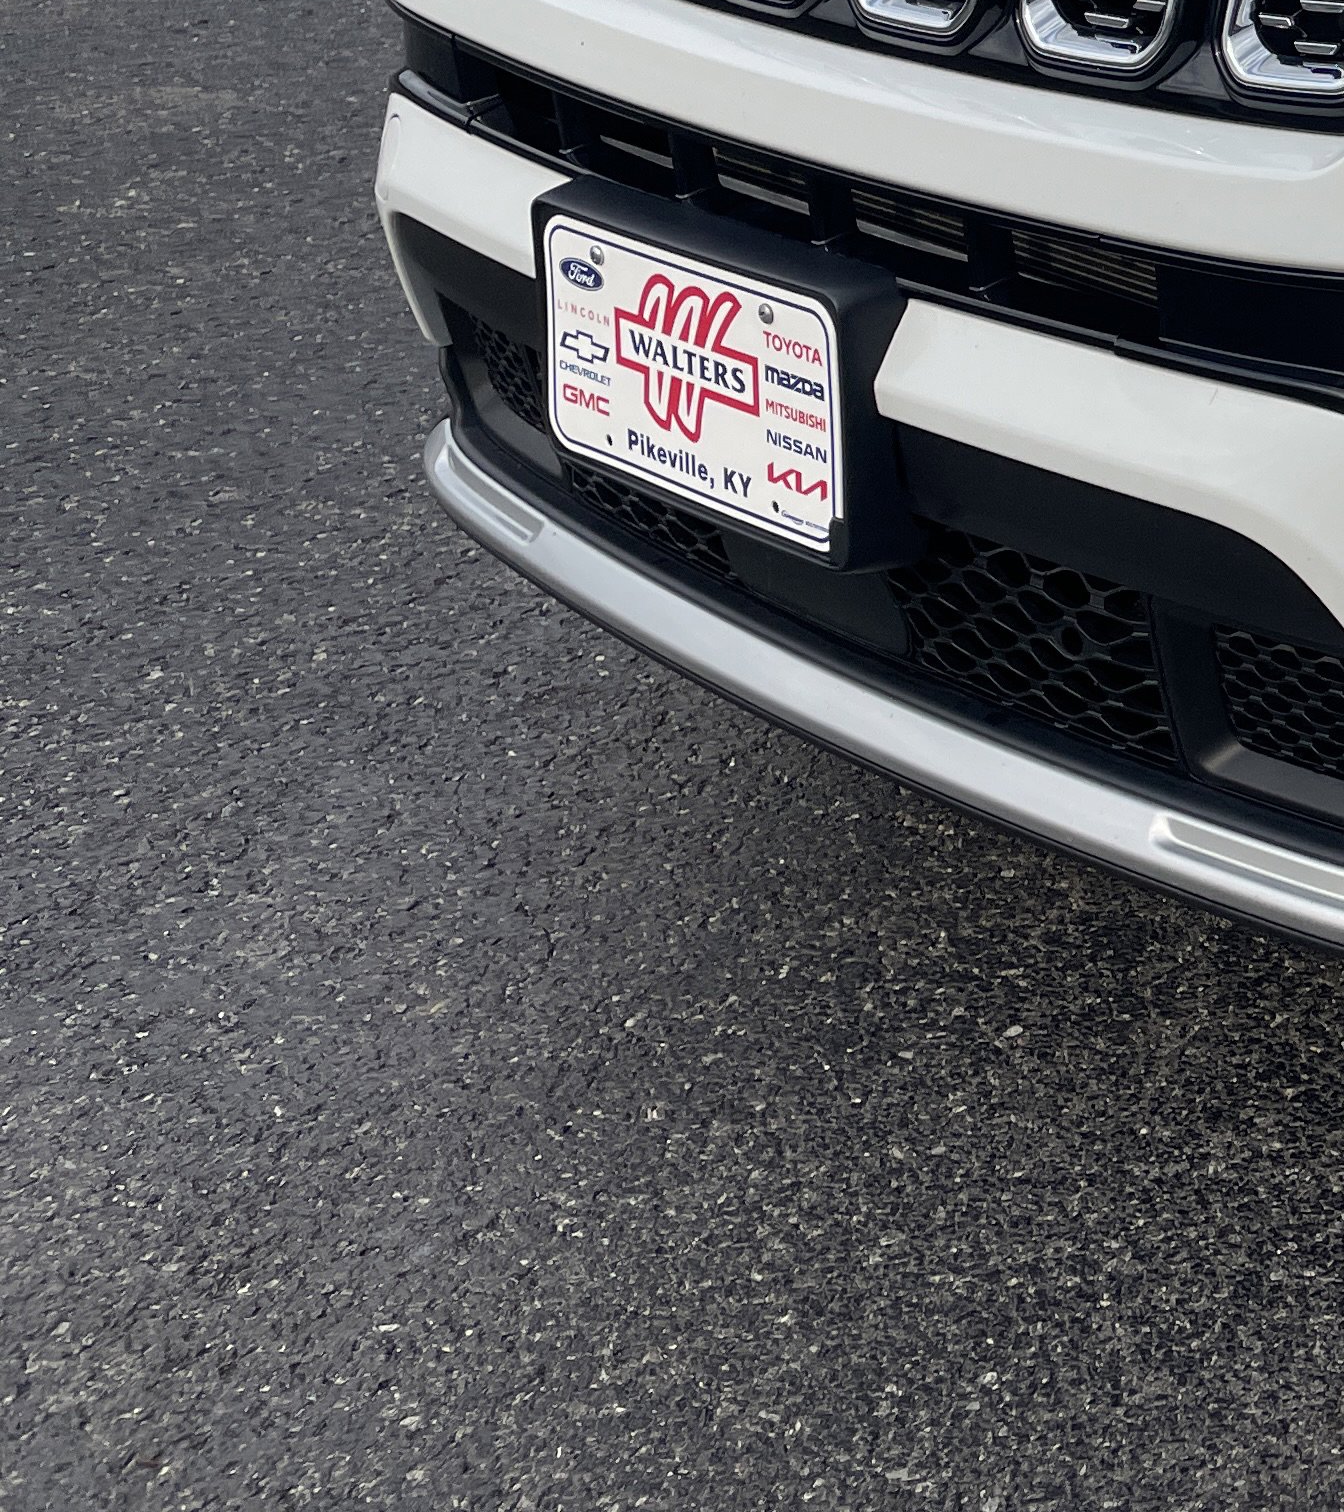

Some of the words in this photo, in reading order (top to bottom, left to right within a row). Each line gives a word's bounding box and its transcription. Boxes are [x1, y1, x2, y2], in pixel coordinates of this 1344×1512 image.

[568, 262, 595, 287] Ford
[557, 299, 610, 327] LINCOLN
[628, 328, 746, 393] WALTERS
[762, 330, 823, 367] TOYOTA
[559, 359, 612, 387] CHEVROLET
[563, 383, 610, 417] GMC
[765, 398, 827, 432] MITSUBISHI
[627, 428, 715, 489] Pikeville,
[723, 467, 752, 498] KY
[766, 429, 828, 464] NISSAN
